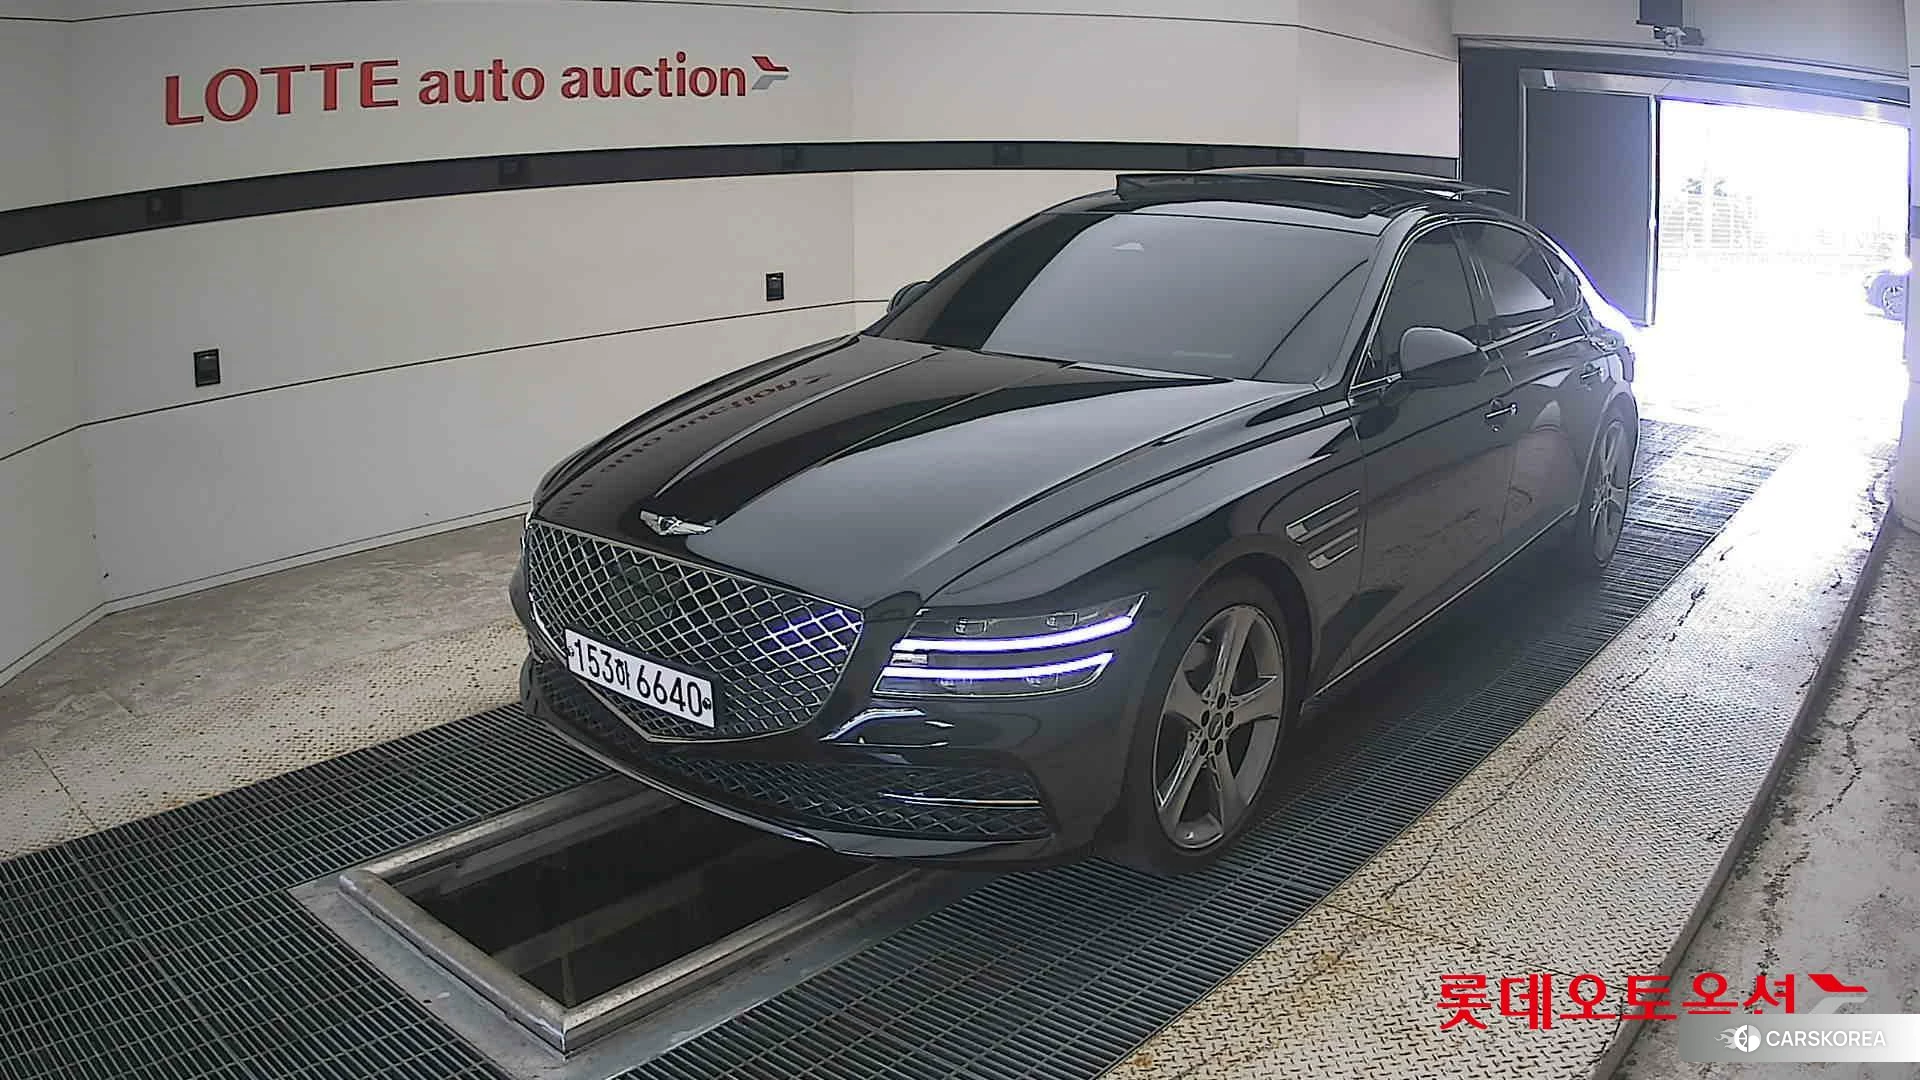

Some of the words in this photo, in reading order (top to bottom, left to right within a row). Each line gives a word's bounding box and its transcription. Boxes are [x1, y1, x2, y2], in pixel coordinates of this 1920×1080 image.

[165, 59, 399, 126] LOTTE
[418, 59, 545, 104] auto
[561, 51, 746, 99] auction
[574, 639, 630, 690] 153하
[636, 664, 703, 717] 6640
